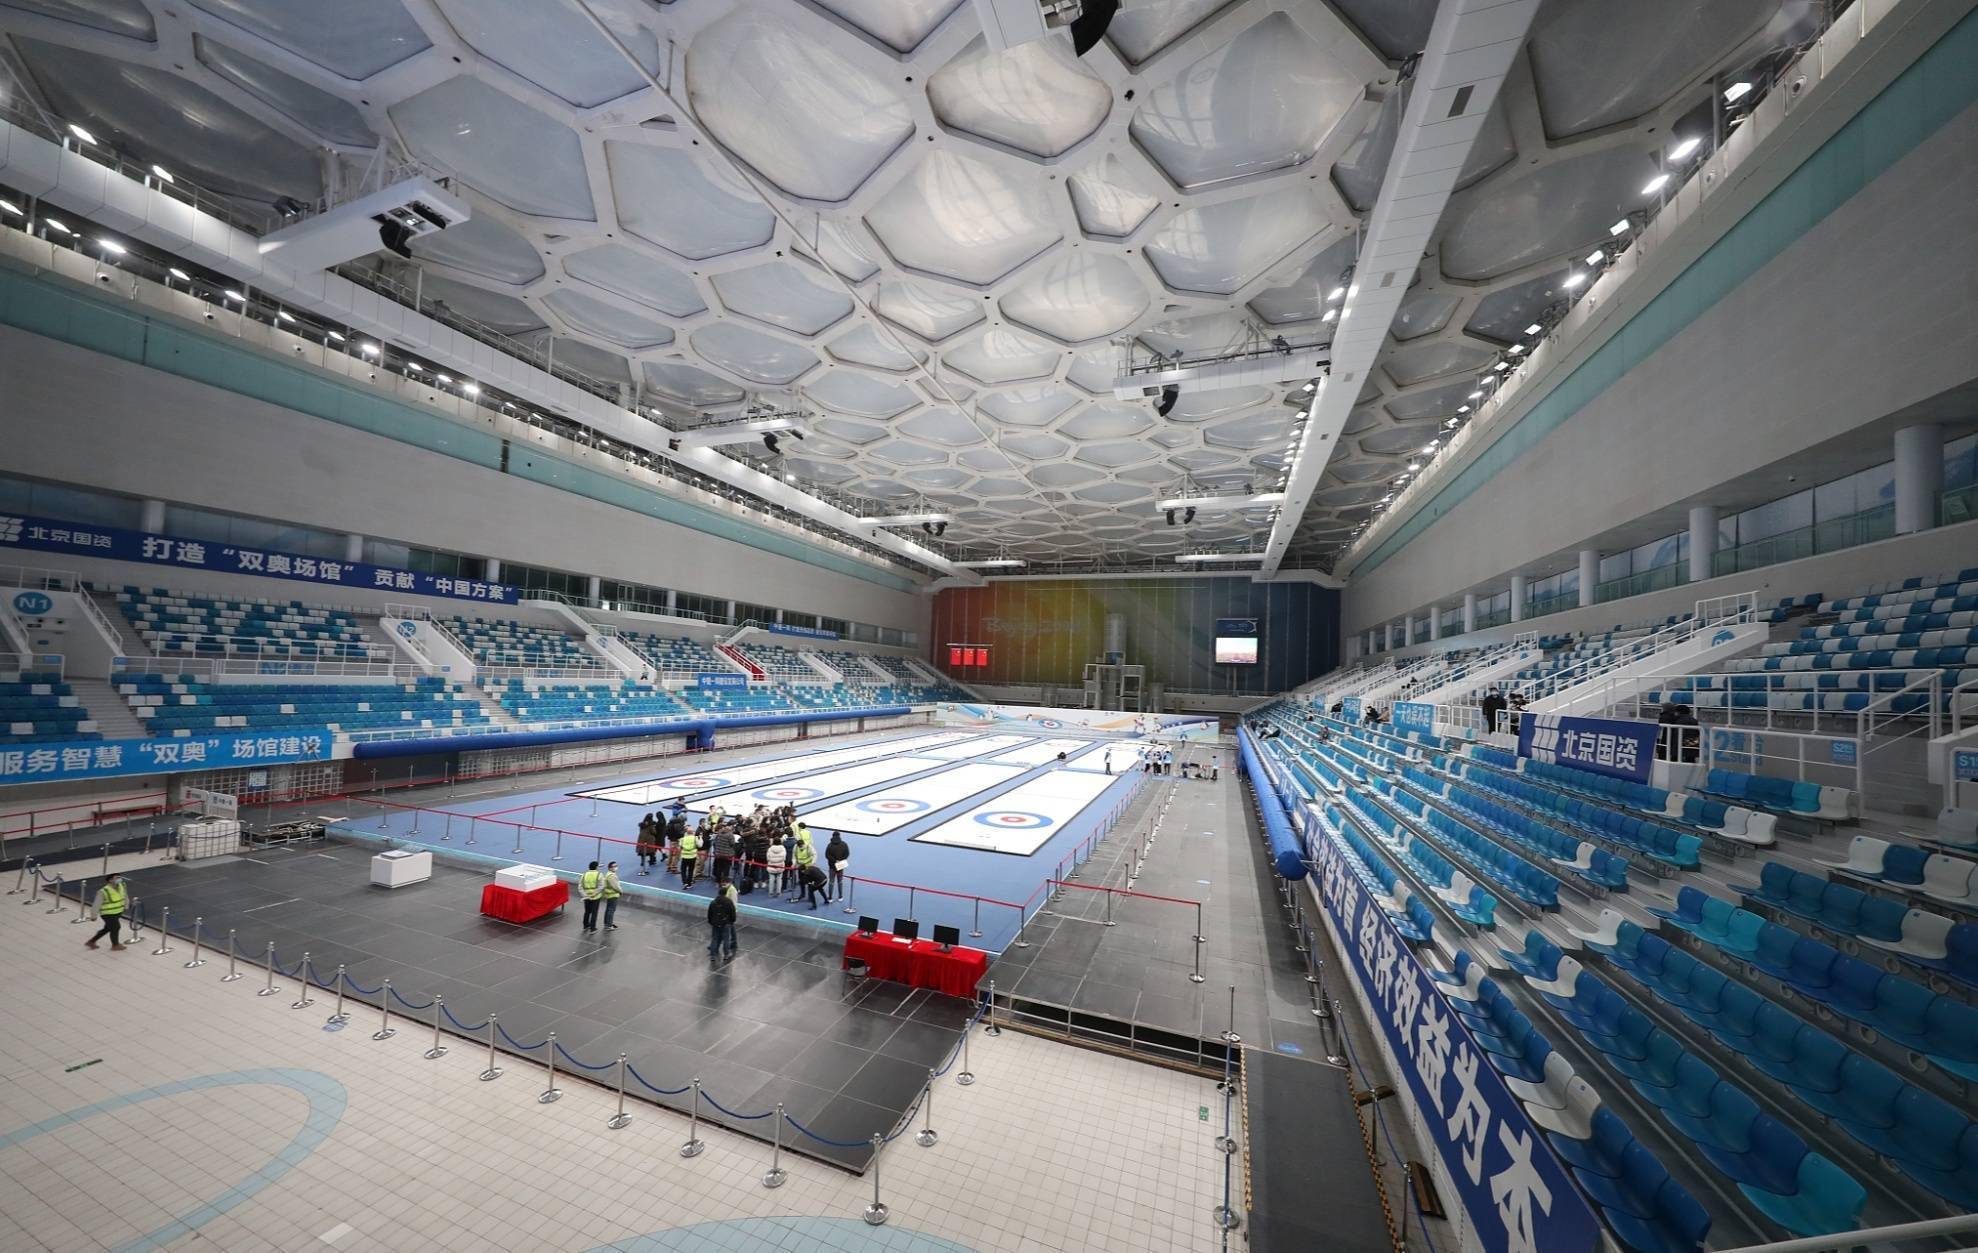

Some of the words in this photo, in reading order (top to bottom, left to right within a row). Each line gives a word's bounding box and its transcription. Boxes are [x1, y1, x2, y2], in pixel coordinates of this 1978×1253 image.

[28, 526, 112, 548] 北京国资
[142, 537, 206, 564] 打造
[222, 548, 355, 581] “双奥场馆”
[374, 568, 415, 589] 贡献
[425, 576, 513, 601] “中国方案”
[18, 596, 49, 609] N1
[0, 744, 122, 775] 服务智慧
[139, 739, 220, 765] “双奥”
[231, 735, 321, 759] 场馆建设
[1562, 729, 1639, 772] 北京国资
[1358, 903, 1553, 1253] 经济效益为本
